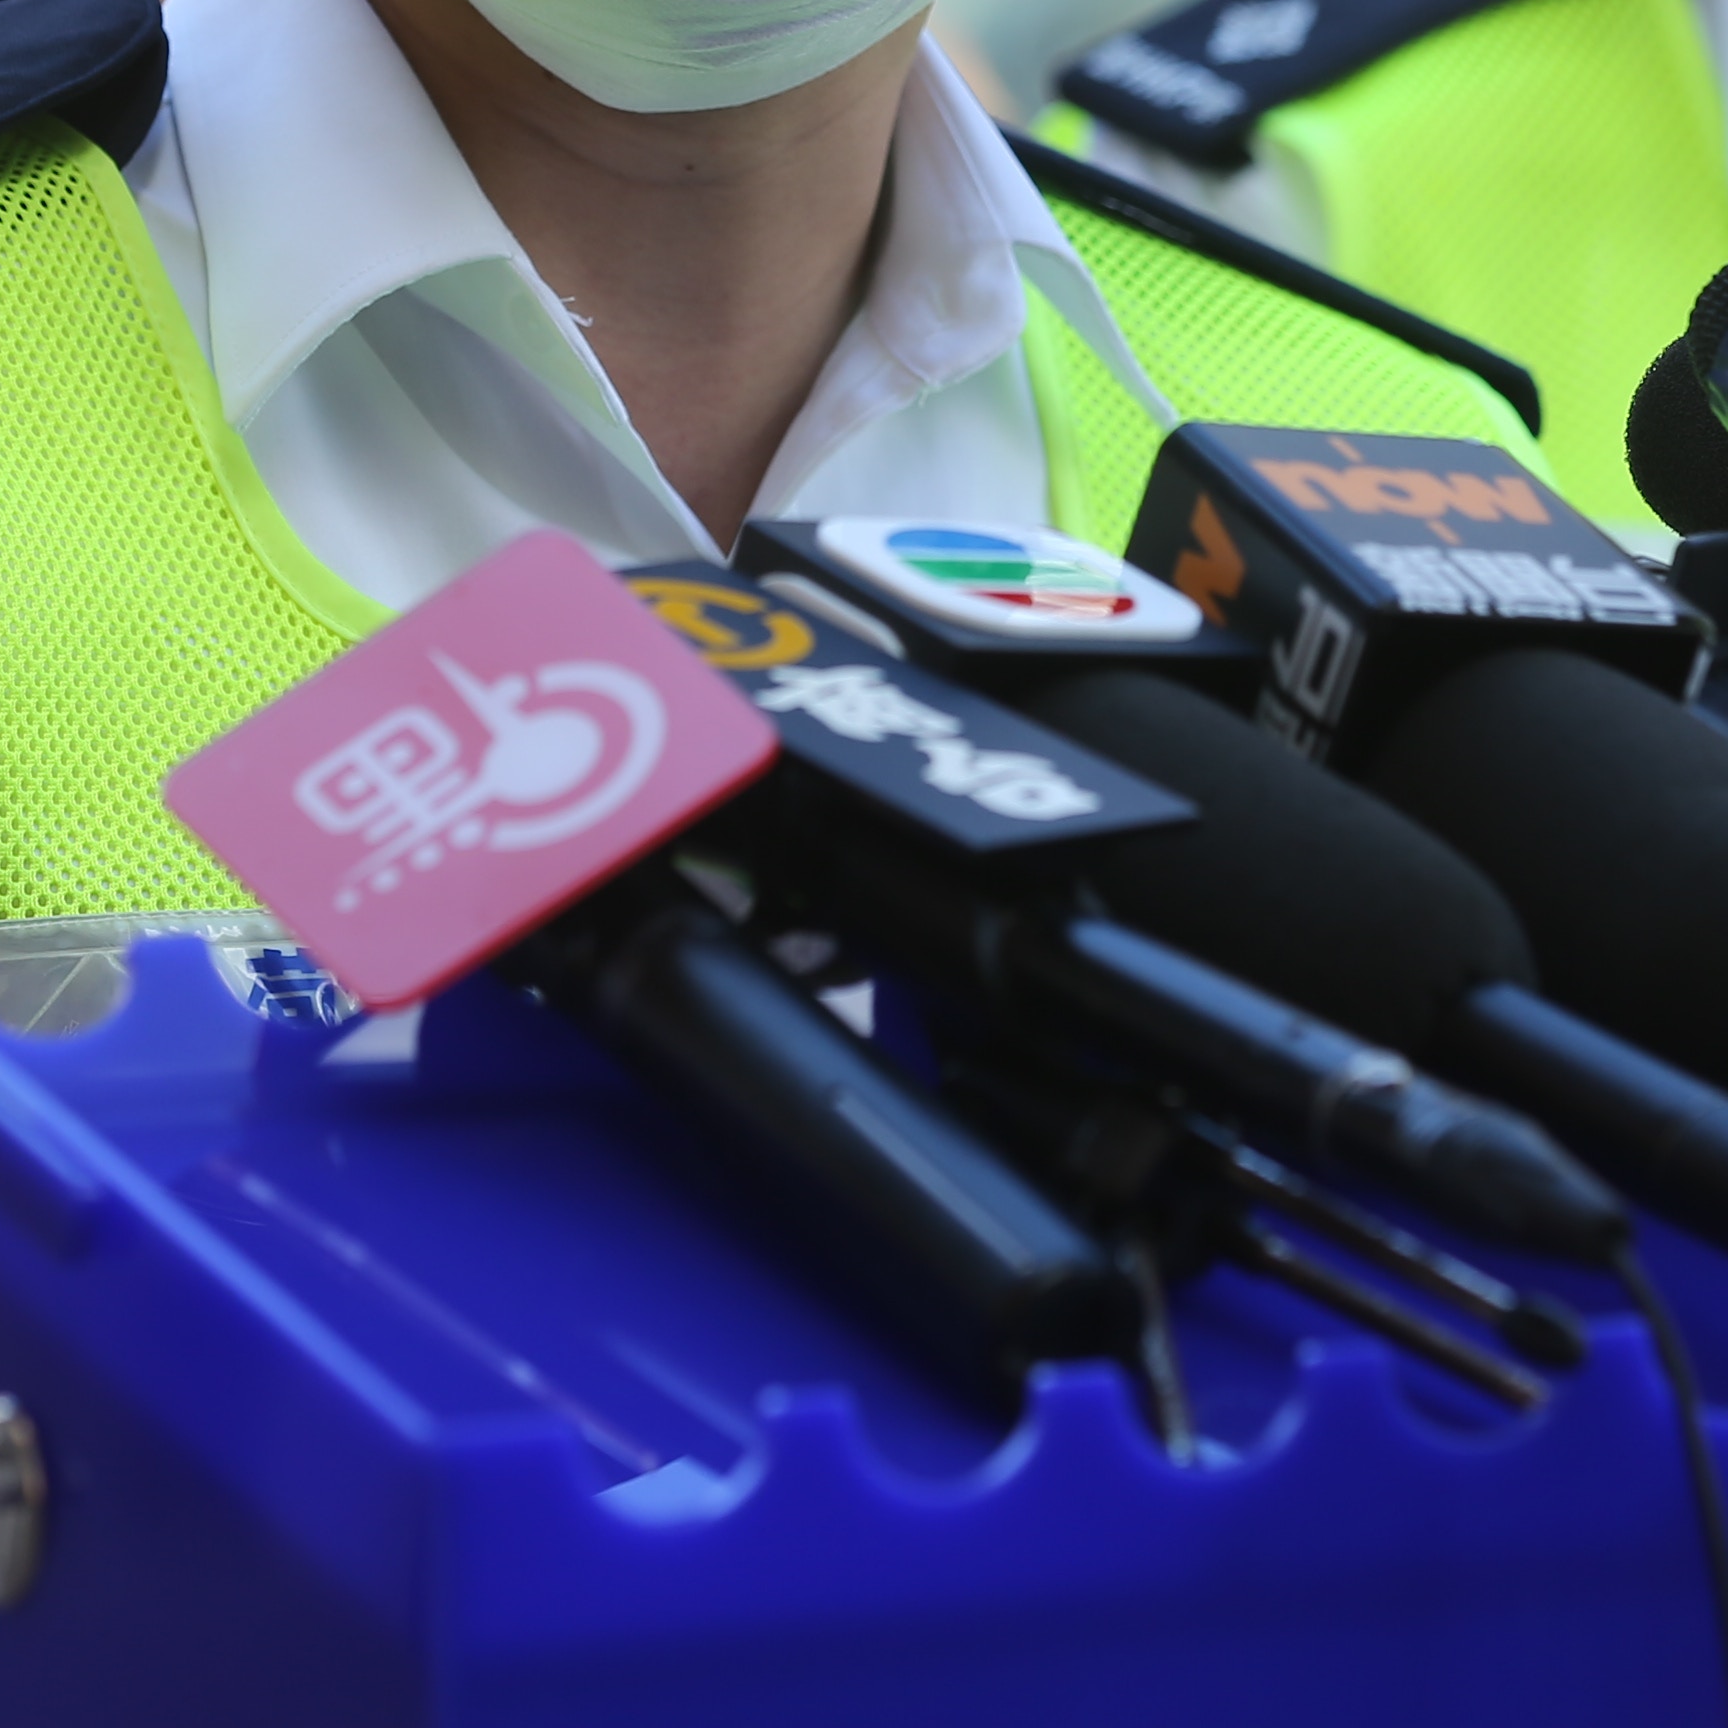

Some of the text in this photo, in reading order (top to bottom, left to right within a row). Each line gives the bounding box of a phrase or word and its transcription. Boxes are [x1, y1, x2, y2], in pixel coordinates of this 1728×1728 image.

[1250, 457, 1552, 526] now
[1353, 542, 1677, 627] 新聞台
